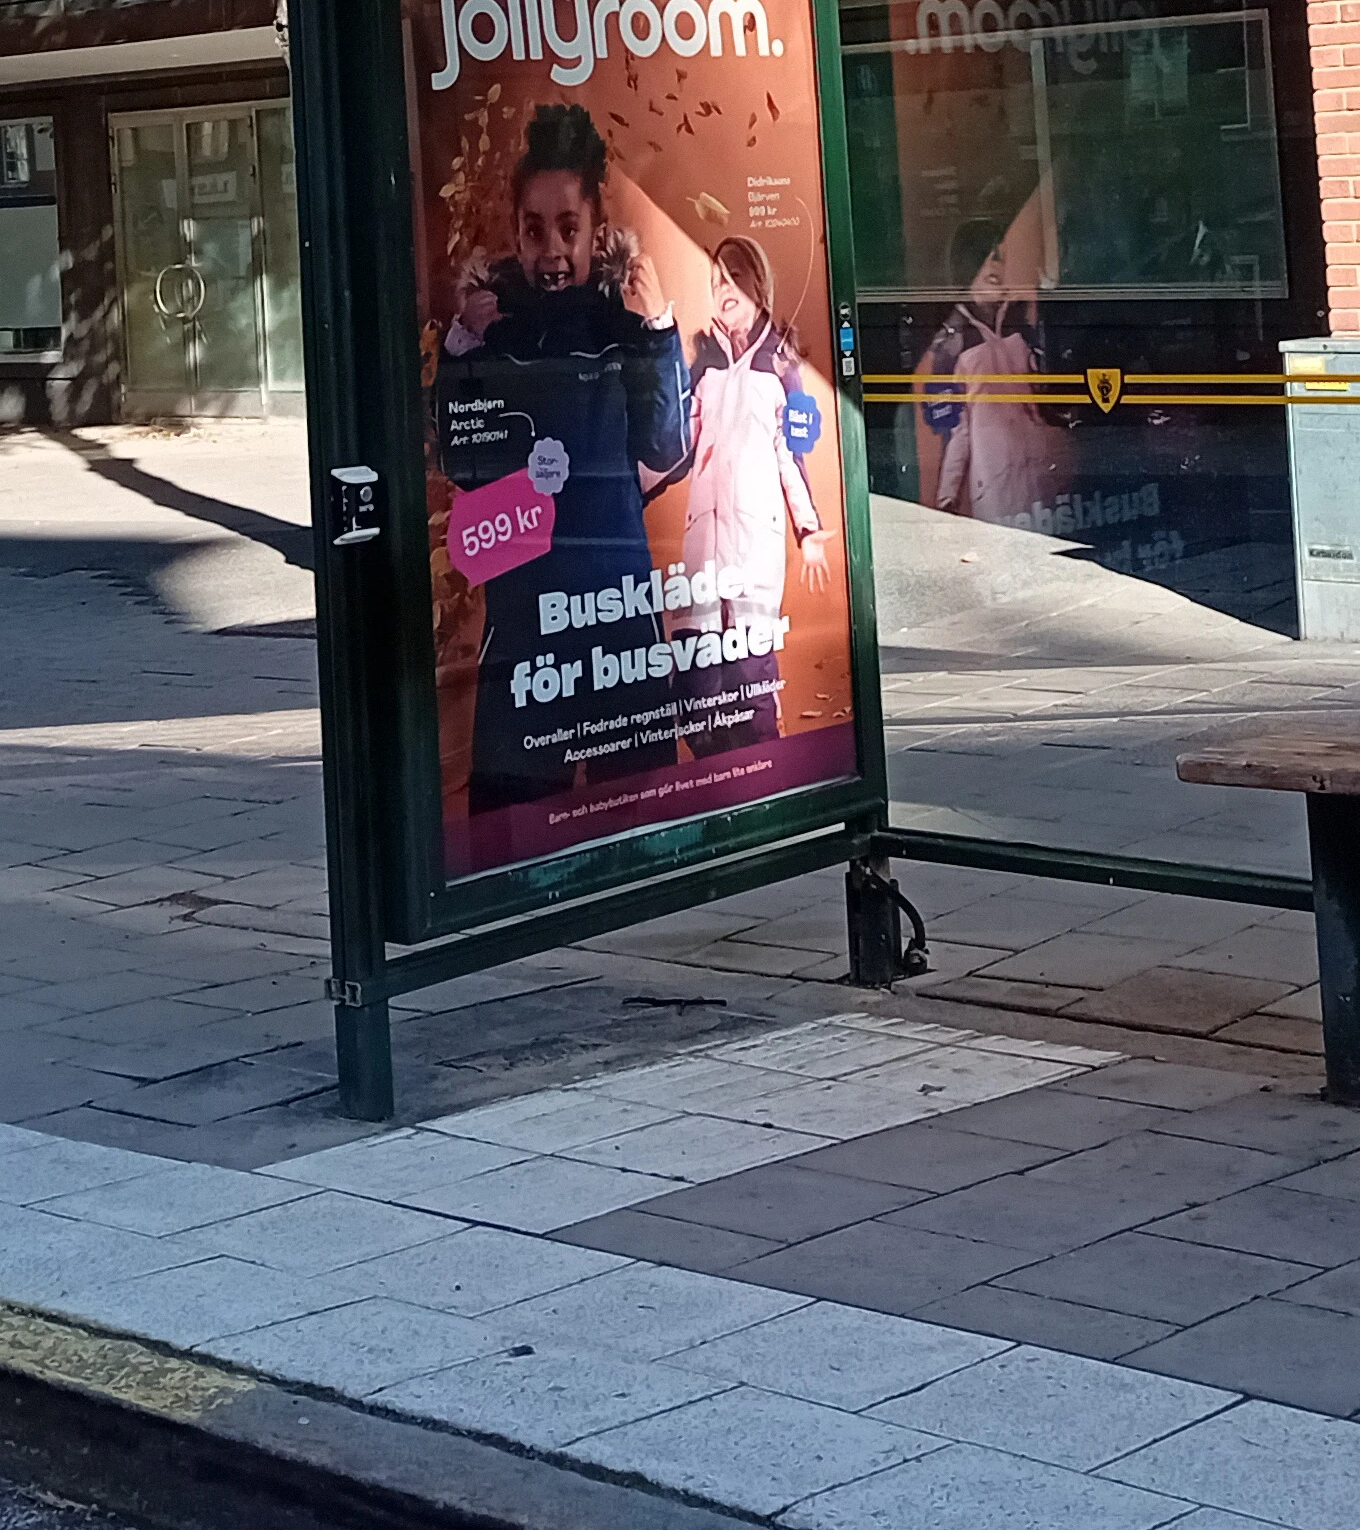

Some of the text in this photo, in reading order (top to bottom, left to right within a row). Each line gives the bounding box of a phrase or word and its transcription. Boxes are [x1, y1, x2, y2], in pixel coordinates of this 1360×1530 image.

[450, 417, 486, 432] Arctic
[461, 505, 543, 557] 599 kr
[538, 560, 764, 636] Buskläde
[510, 615, 791, 708] för busväder
[523, 727, 576, 750] Overaller
[583, 714, 629, 736] Fodrade
[630, 700, 678, 726] regnställ
[684, 690, 740, 712] Vinterskor
[564, 709, 756, 764] Accessoarer Vinterjackor Åkpåsar
